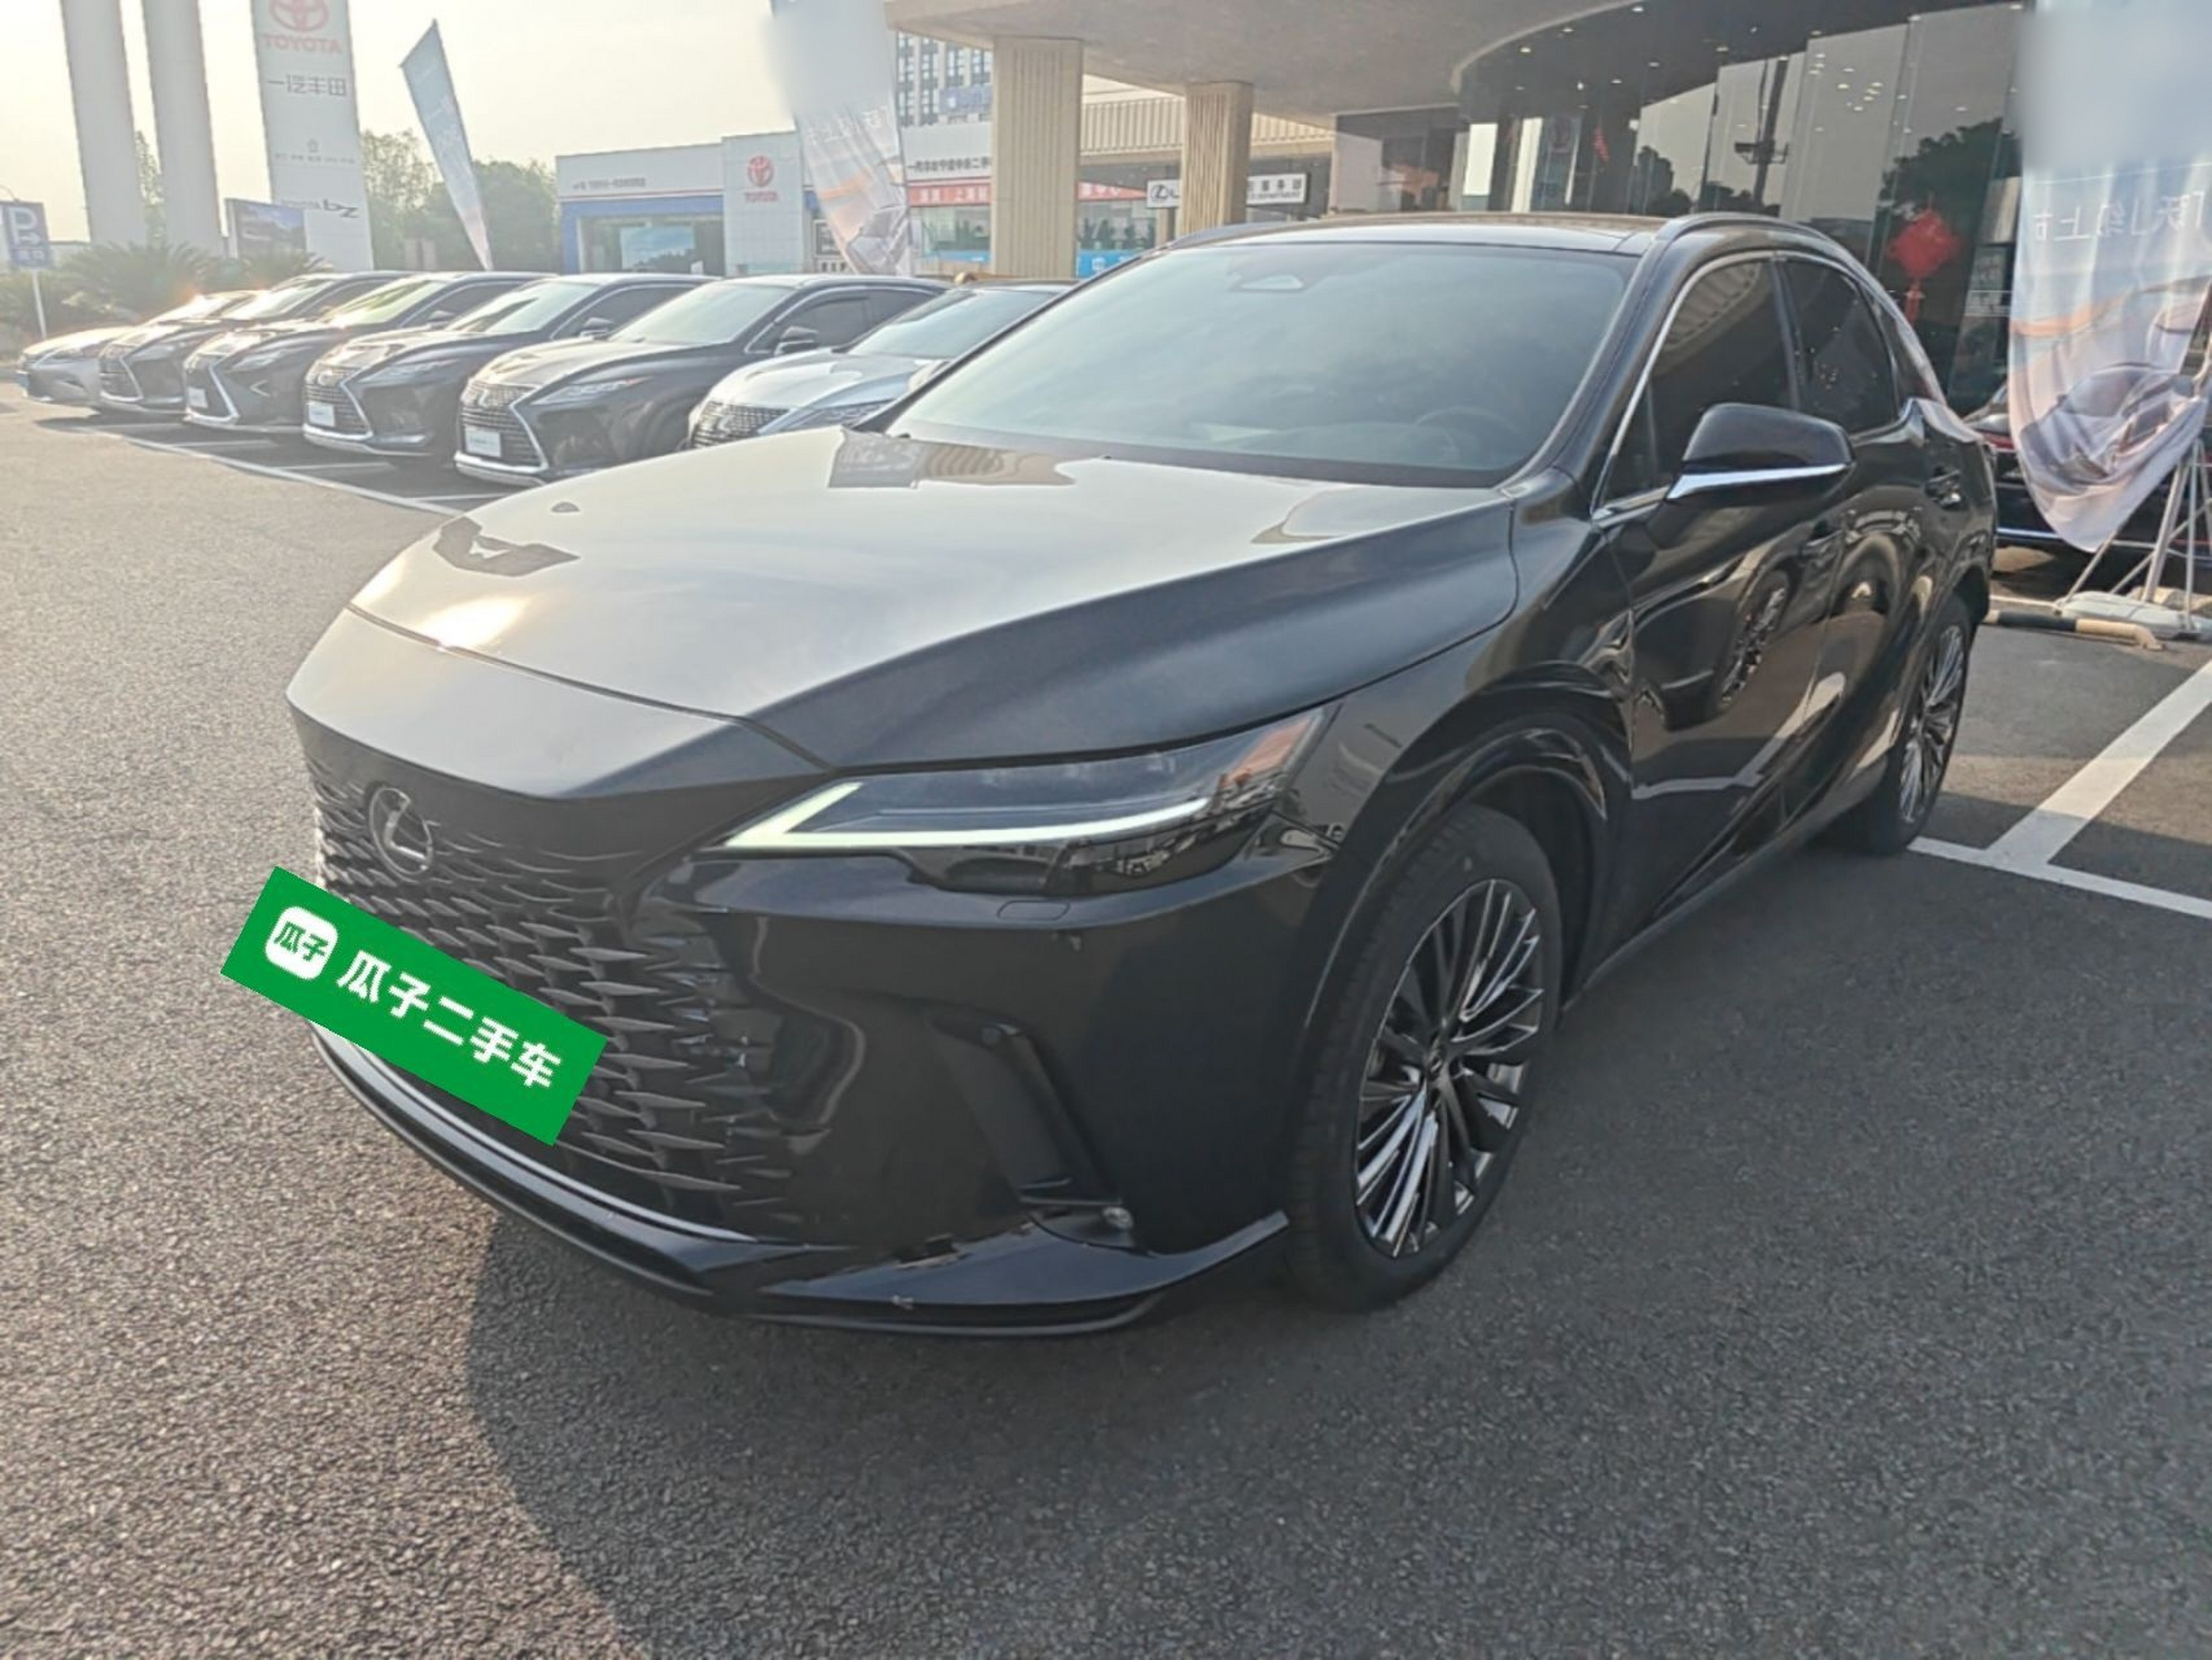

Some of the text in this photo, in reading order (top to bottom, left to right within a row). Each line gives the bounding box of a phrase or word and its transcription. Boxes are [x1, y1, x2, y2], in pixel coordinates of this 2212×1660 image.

[263, 33, 343, 55] TOYOTA
[267, 74, 347, 96] 一汽丰田
[9, 207, 37, 245] P
